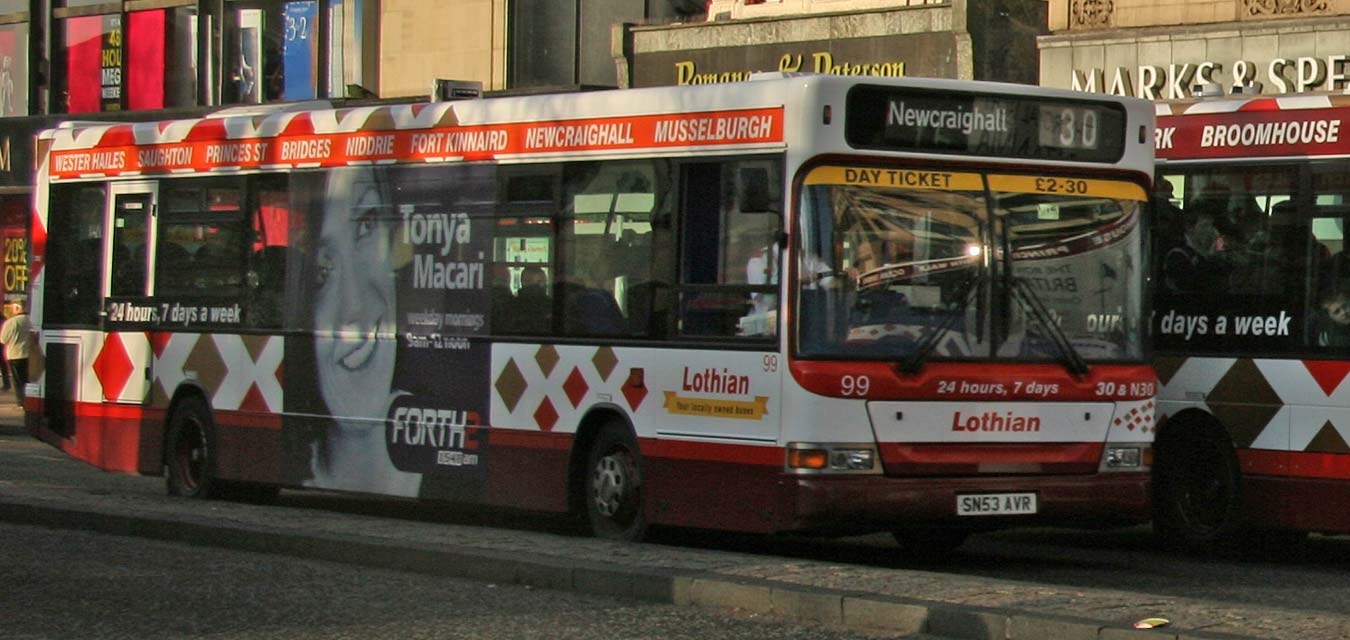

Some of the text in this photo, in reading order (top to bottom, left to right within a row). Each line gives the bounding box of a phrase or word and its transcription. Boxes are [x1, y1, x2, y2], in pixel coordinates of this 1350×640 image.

[886, 100, 1008, 134] Newcraighall
[525, 122, 634, 149] NEWCRAIGHALL
[654, 115, 773, 143] MUSSELBURGH
[1200, 119, 1341, 148] BROOMHOUSE
[205, 142, 269, 164] PRINCES ST
[281, 138, 332, 160] BRIDGES
[345, 134, 396, 157] NIDDRIE
[410, 130, 508, 154] FORT KINNAIRD
[55, 151, 126, 172] WESTER HAILES
[138, 147, 193, 168] SAUGHTON
[844, 168, 881, 184] DAY
[887, 170, 953, 188] TICKET
[400, 204, 471, 257] Tonya
[413, 251, 485, 289] Macari
[110, 302, 125, 322] 24
[162, 303, 170, 322] 7
[171, 302, 198, 327] days
[201, 306, 209, 322] a
[210, 303, 242, 324] week
[1161, 310, 1208, 341] days
[1215, 315, 1228, 336] a
[1234, 310, 1293, 337] week
[763, 354, 778, 373] 99
[682, 366, 750, 395] Lothian
[840, 374, 870, 396] 99
[937, 381, 1059, 398] 24 hours, 7 days
[1095, 381, 1155, 397] 30 & N30
[951, 411, 1041, 433] Lothian
[962, 496, 1032, 513] SN53 AVR
